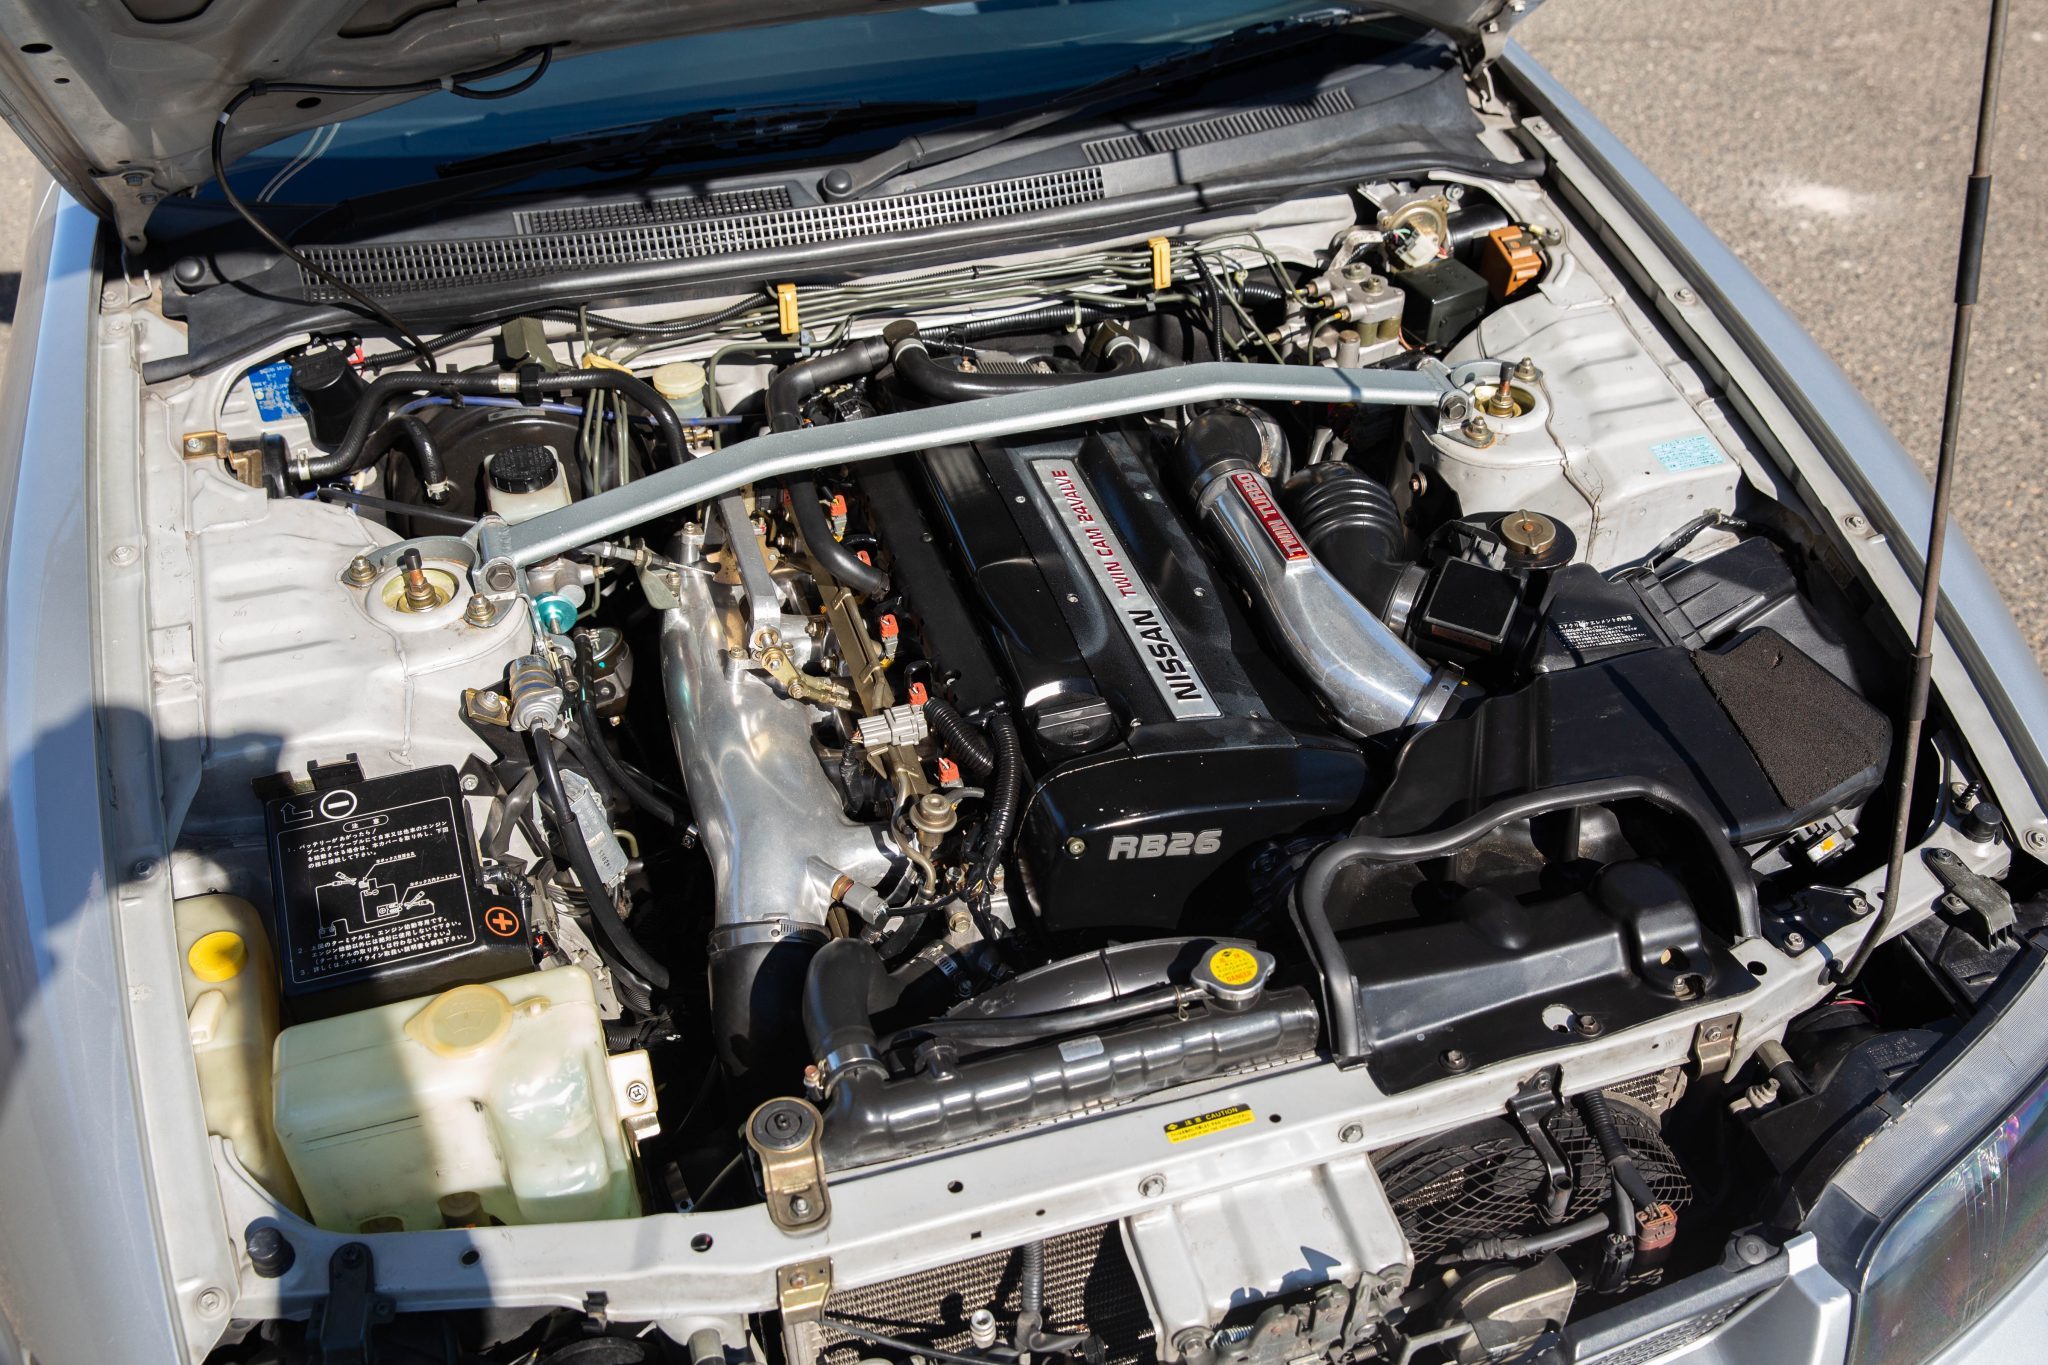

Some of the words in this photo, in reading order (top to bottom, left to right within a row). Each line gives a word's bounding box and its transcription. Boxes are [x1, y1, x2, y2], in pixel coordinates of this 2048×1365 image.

[1051, 470, 1095, 524] 24VALVE
[1236, 472, 1277, 519] TURBO
[1085, 528, 1114, 558] CAM
[1268, 519, 1304, 559] TWIN
[1103, 561, 1137, 600] TWIN
[1128, 609, 1203, 703] NISSAN
[1108, 829, 1223, 861] RB26
[1205, 1107, 1239, 1120] CAUTION
